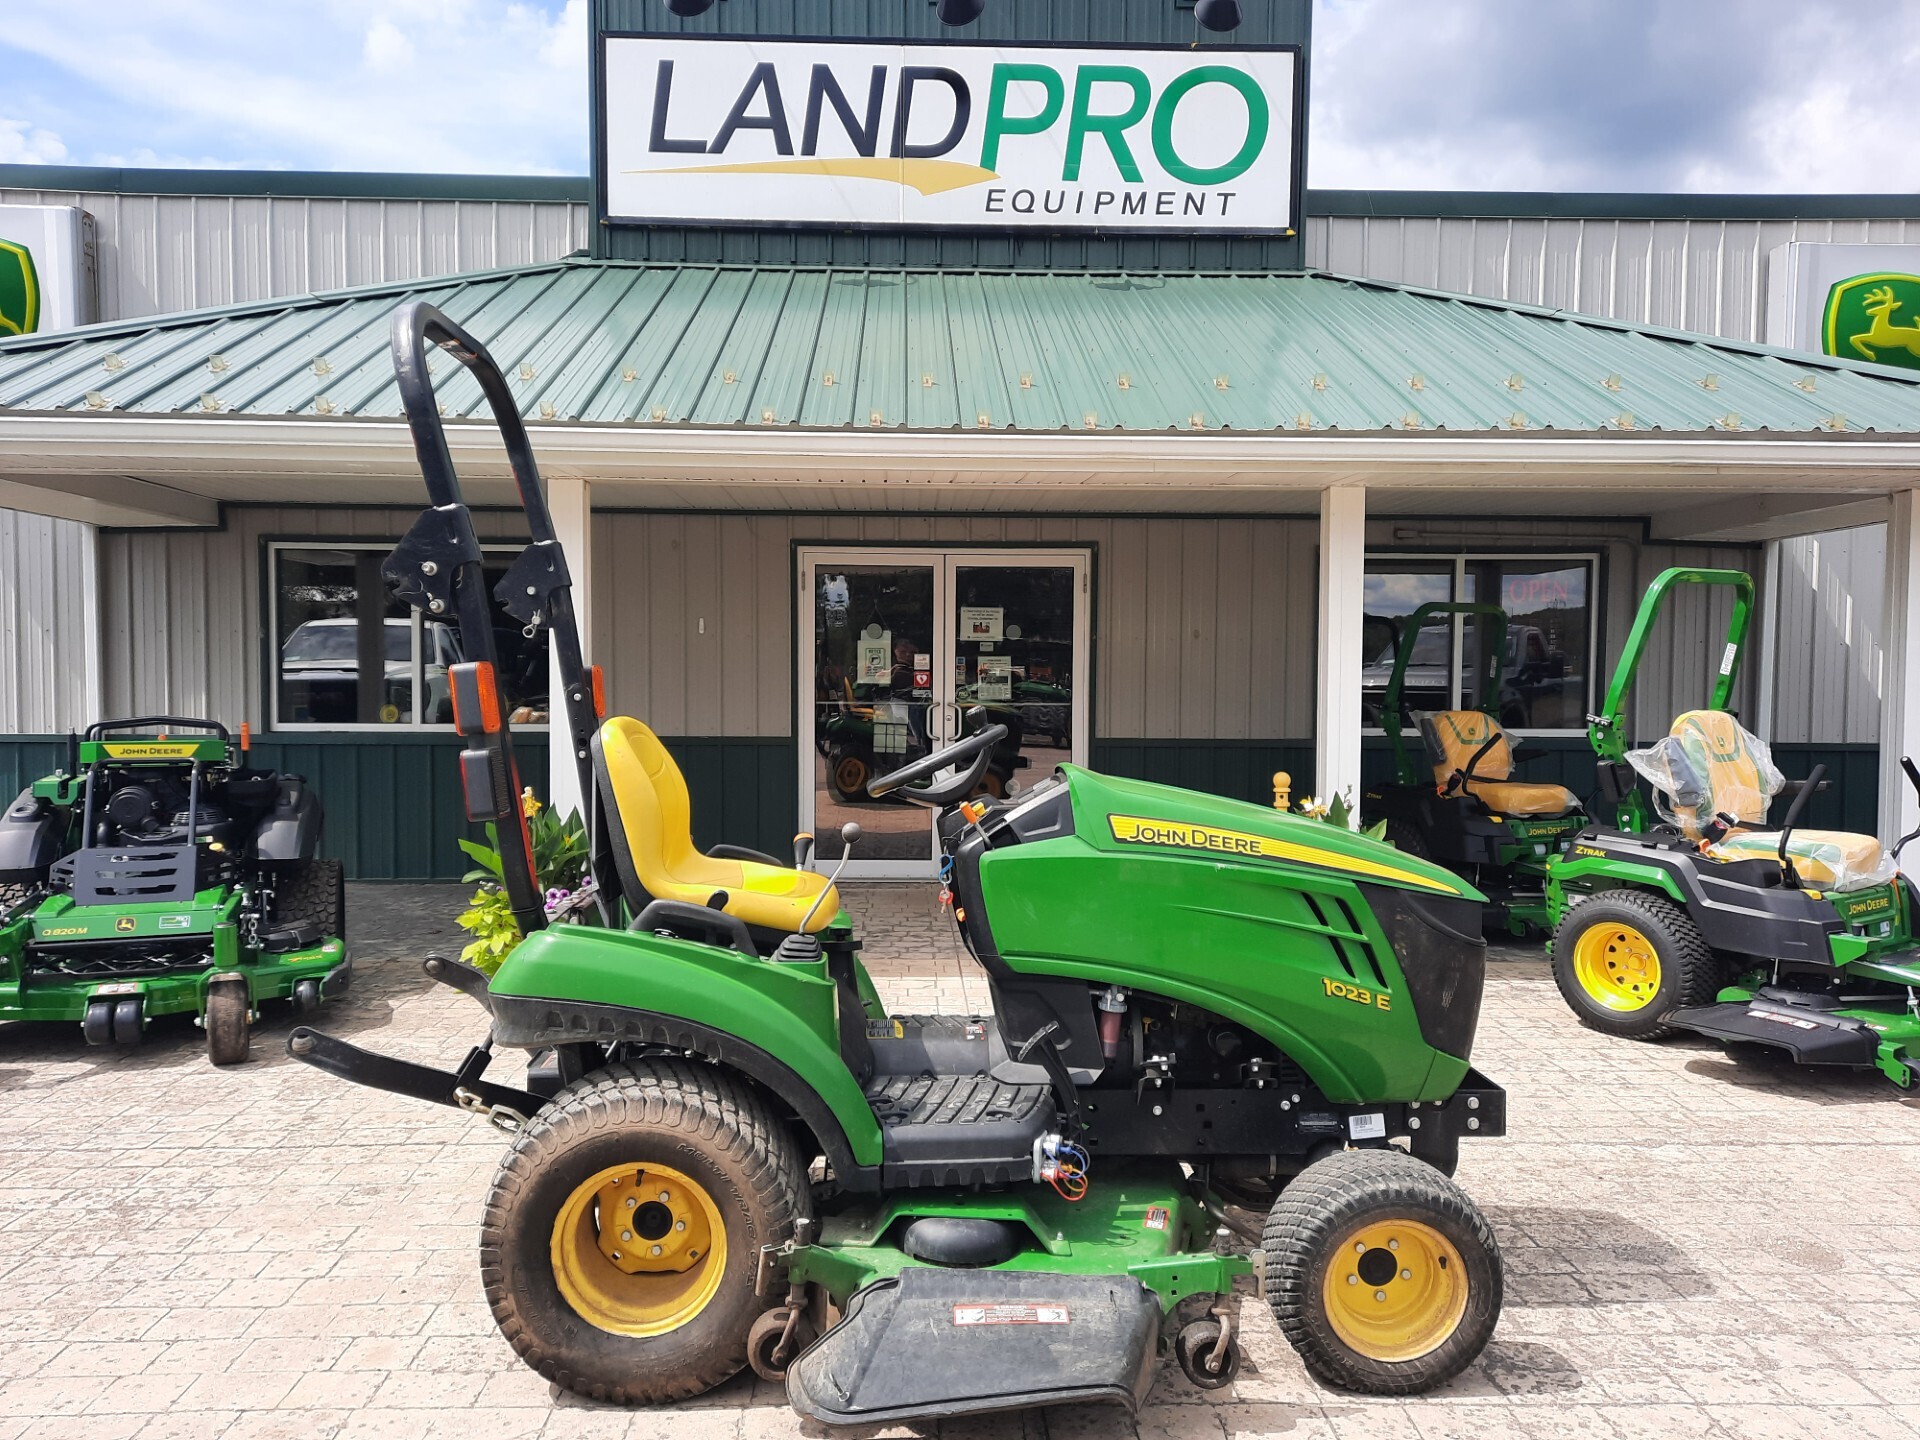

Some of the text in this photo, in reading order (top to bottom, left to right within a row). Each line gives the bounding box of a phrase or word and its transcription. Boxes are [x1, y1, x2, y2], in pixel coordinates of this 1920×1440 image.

[648, 58, 1270, 186] LANDPRO
[984, 188, 1237, 217] EQUIPMENT
[1509, 578, 1569, 604] OPEN
[120, 747, 183, 755] JOHN DEERE
[1129, 824, 1262, 854] JOHN DEERE
[1528, 828, 1547, 836] JOHN
[1575, 846, 1607, 857] ZTRAK
[1849, 897, 1889, 915] JOHN DEERE
[676, 1142, 731, 1183] MULTI
[730, 1185, 757, 1240] TRAC
